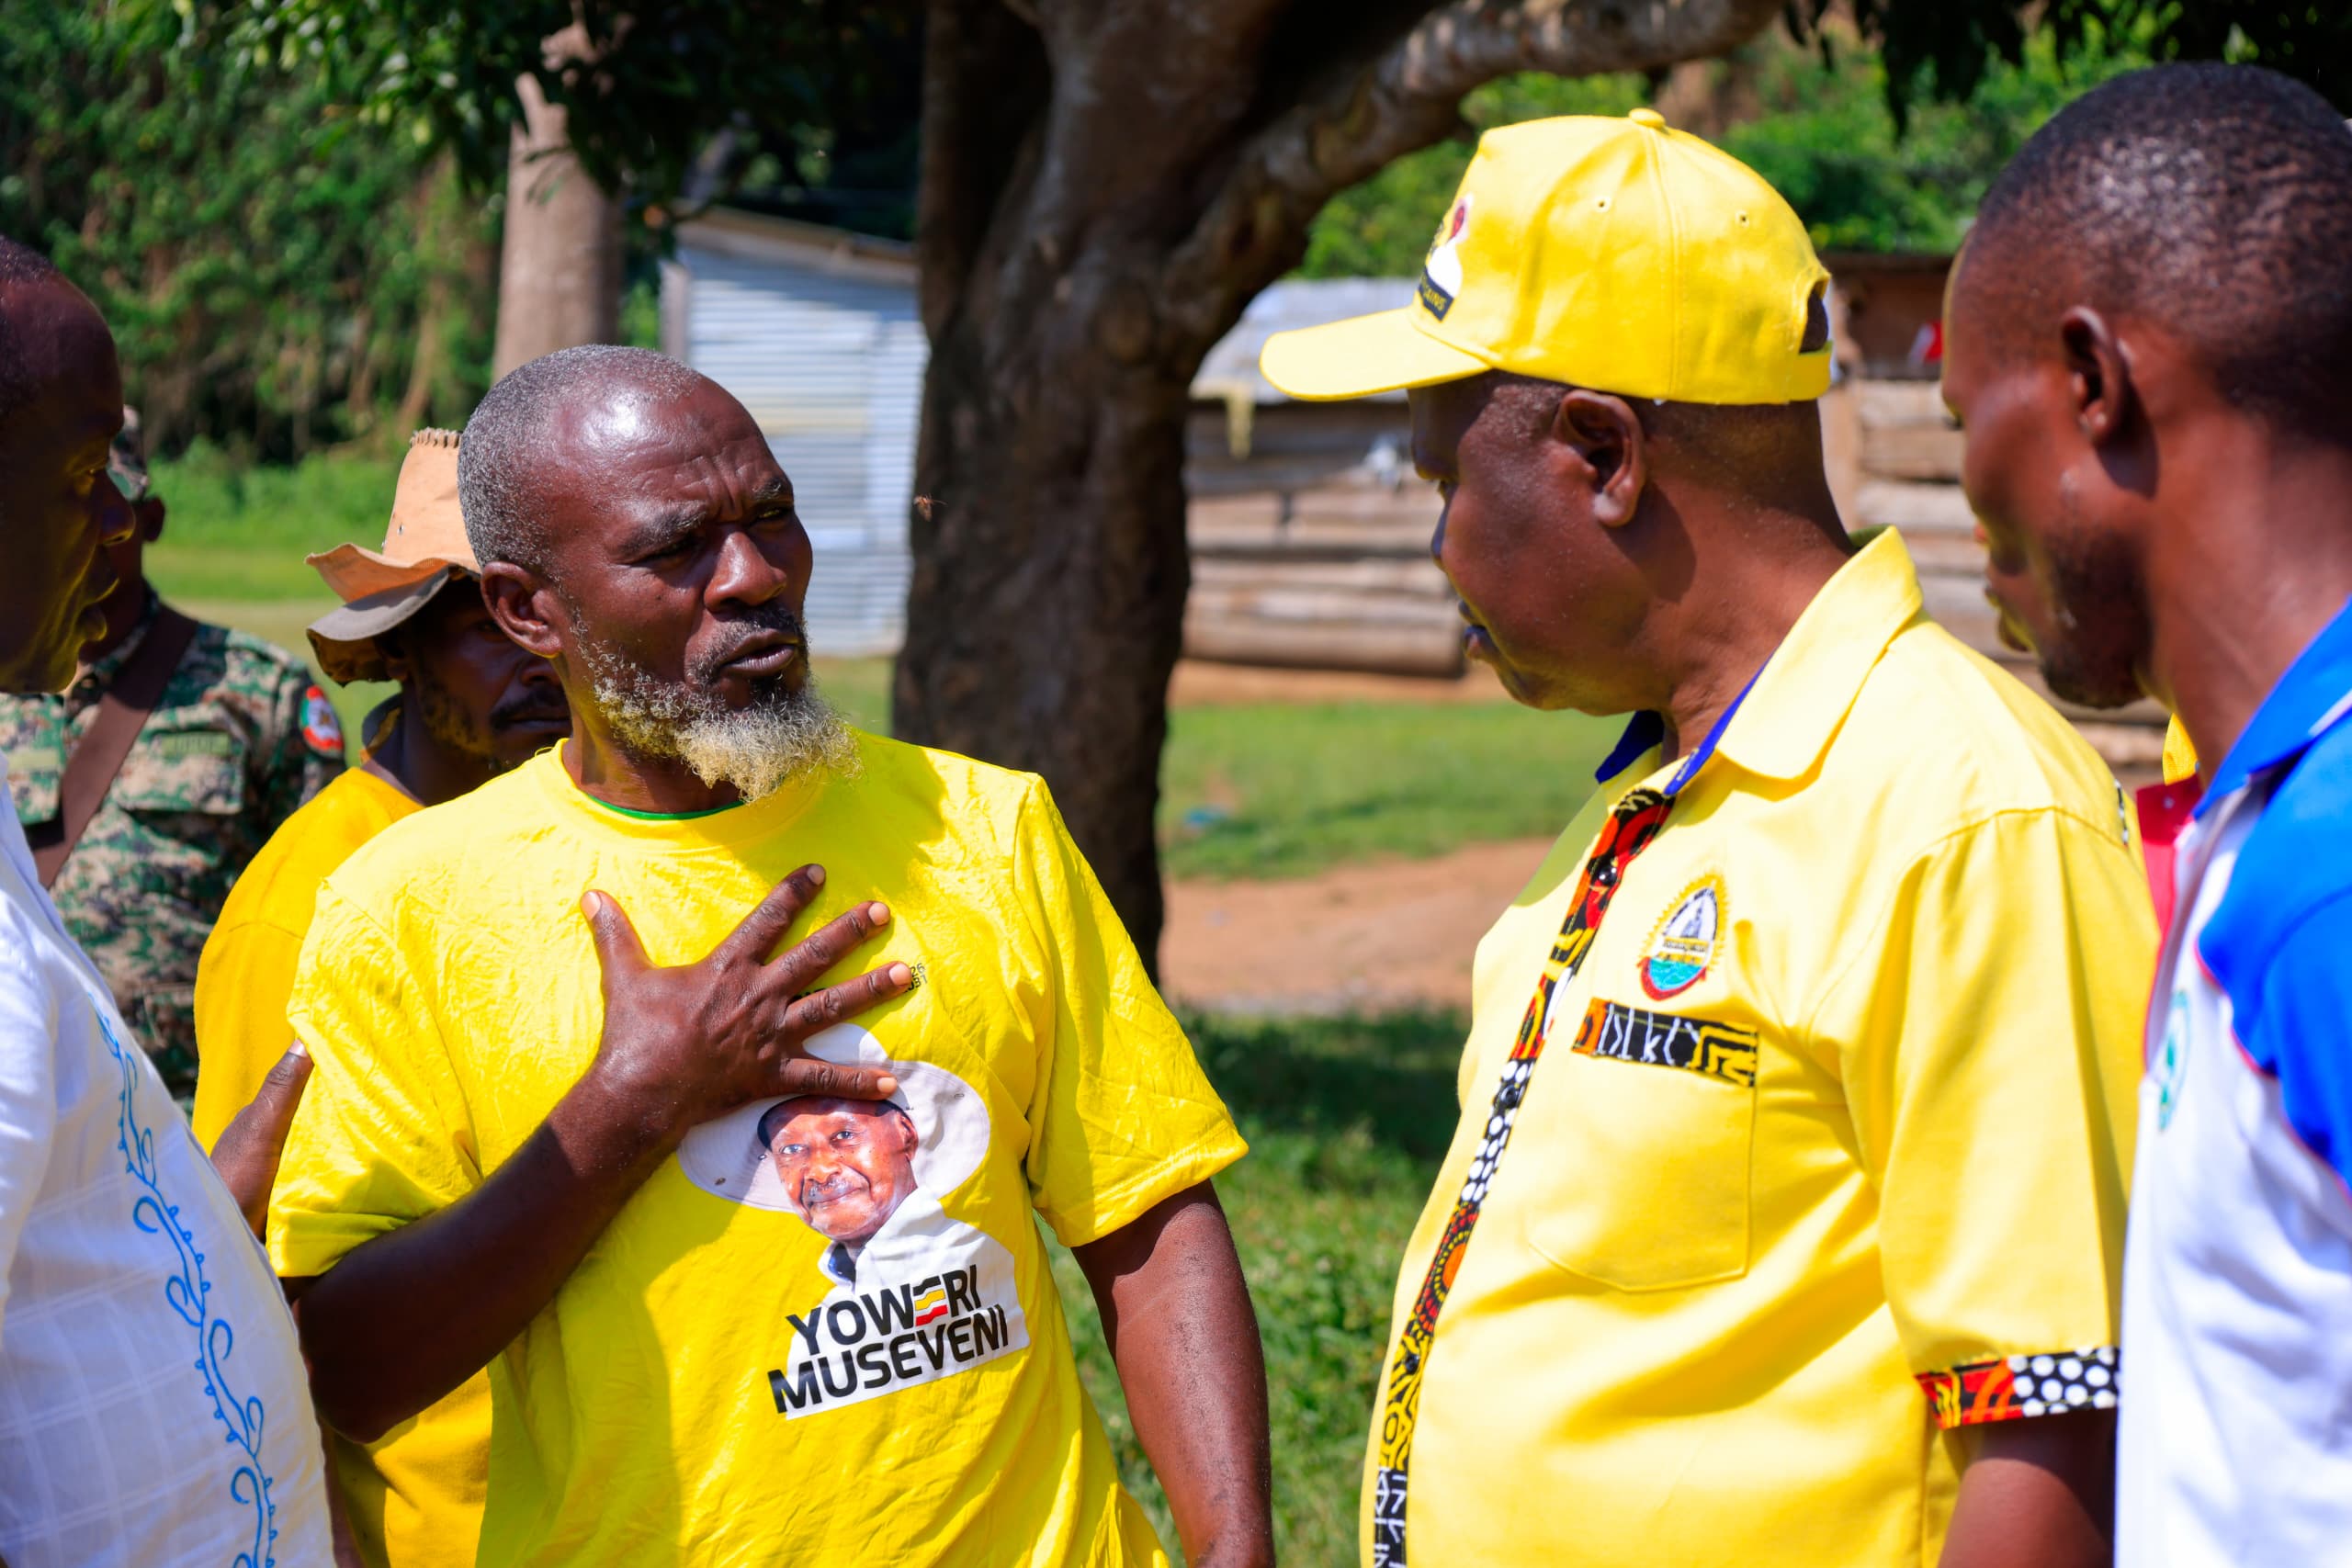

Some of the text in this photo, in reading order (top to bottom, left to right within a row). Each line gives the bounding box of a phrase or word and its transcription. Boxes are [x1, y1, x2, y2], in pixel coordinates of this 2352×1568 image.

[910, 963, 926, 977] 26
[786, 1264, 980, 1356] YOWERI
[767, 1304, 1008, 1414] MUSEVENI
